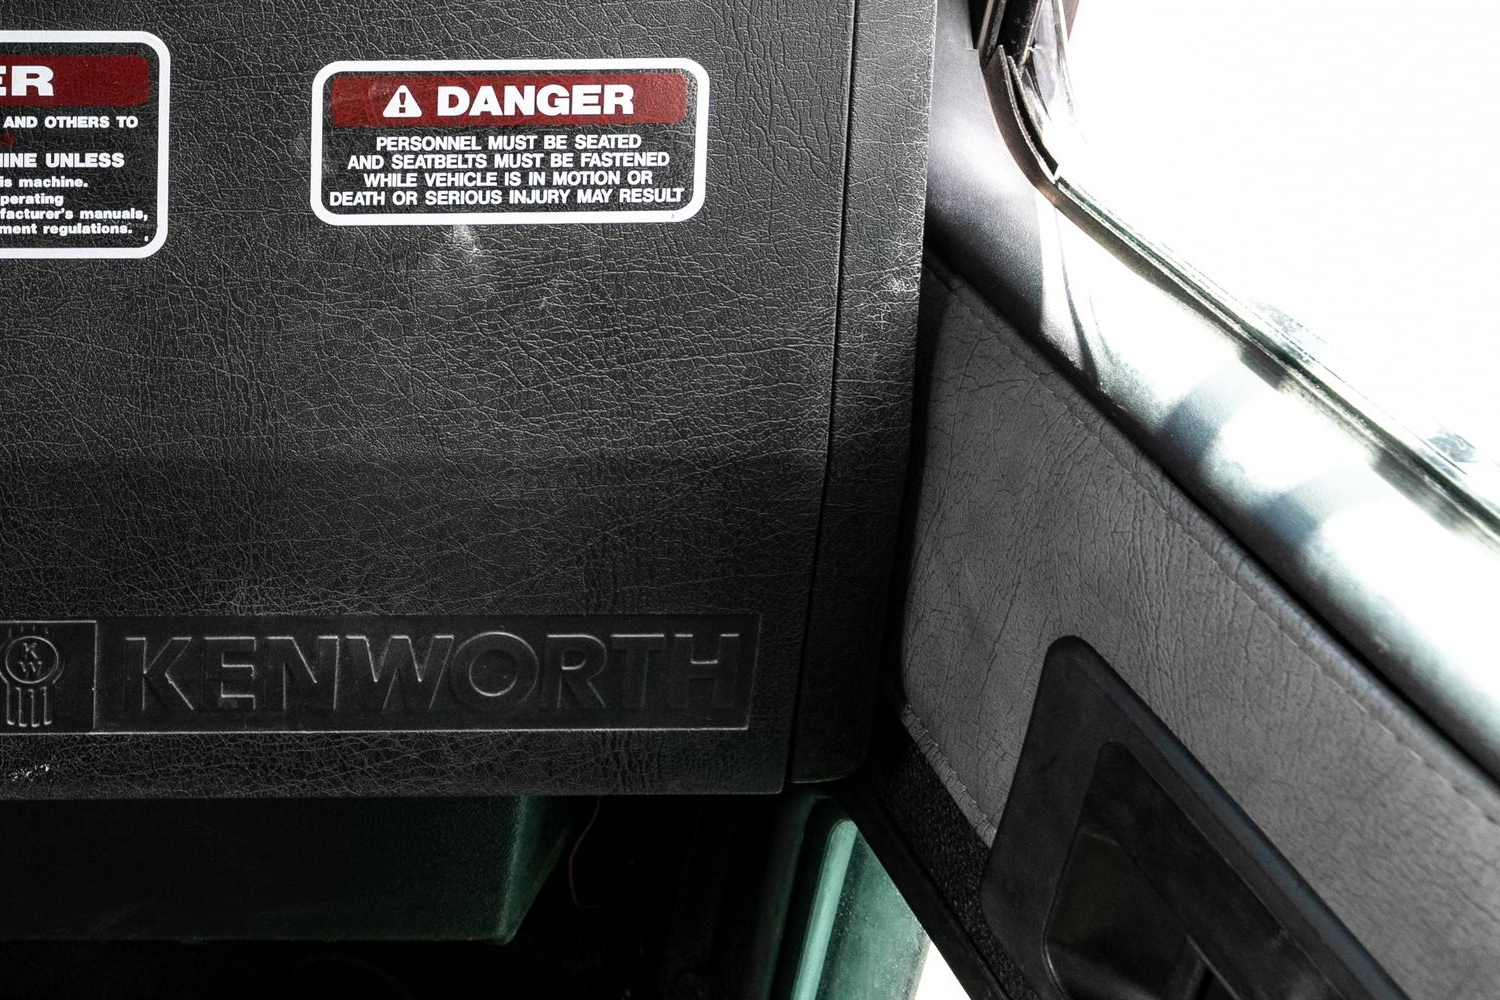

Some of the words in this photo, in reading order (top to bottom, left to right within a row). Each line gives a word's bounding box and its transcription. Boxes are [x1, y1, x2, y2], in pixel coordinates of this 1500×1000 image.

[438, 84, 634, 116] DANGER
[3, 116, 38, 128] AND
[45, 116, 109, 128] OTHERS
[116, 116, 138, 128] TO
[377, 136, 481, 151] PERSONNEL
[489, 135, 537, 150] MUST
[544, 135, 567, 149] BE
[575, 134, 641, 149] SEATED
[46, 153, 124, 168] UNLESS
[348, 155, 384, 169] AND
[392, 154, 487, 169] SEATBELTS
[495, 153, 544, 168] MUST
[551, 153, 573, 167] BE
[581, 152, 670, 167] FASTENED
[19, 176, 88, 187] machine.
[364, 173, 417, 187] WHILE
[425, 172, 497, 187] VEHICLE
[505, 172, 521, 186] IS
[529, 172, 545, 185] IN
[553, 171, 620, 185] MOTION
[627, 170, 652, 185] OR
[330, 191, 385, 206] DEATH
[393, 191, 417, 205] OR
[425, 190, 502, 205] SERIOUS
[510, 189, 570, 204] INJURY
[577, 189, 612, 203] MAY
[620, 188, 684, 202] RESULT
[80, 208, 148, 221] manuals,
[43, 223, 132, 236] regulations.
[124, 631, 741, 711] KENWORTH
